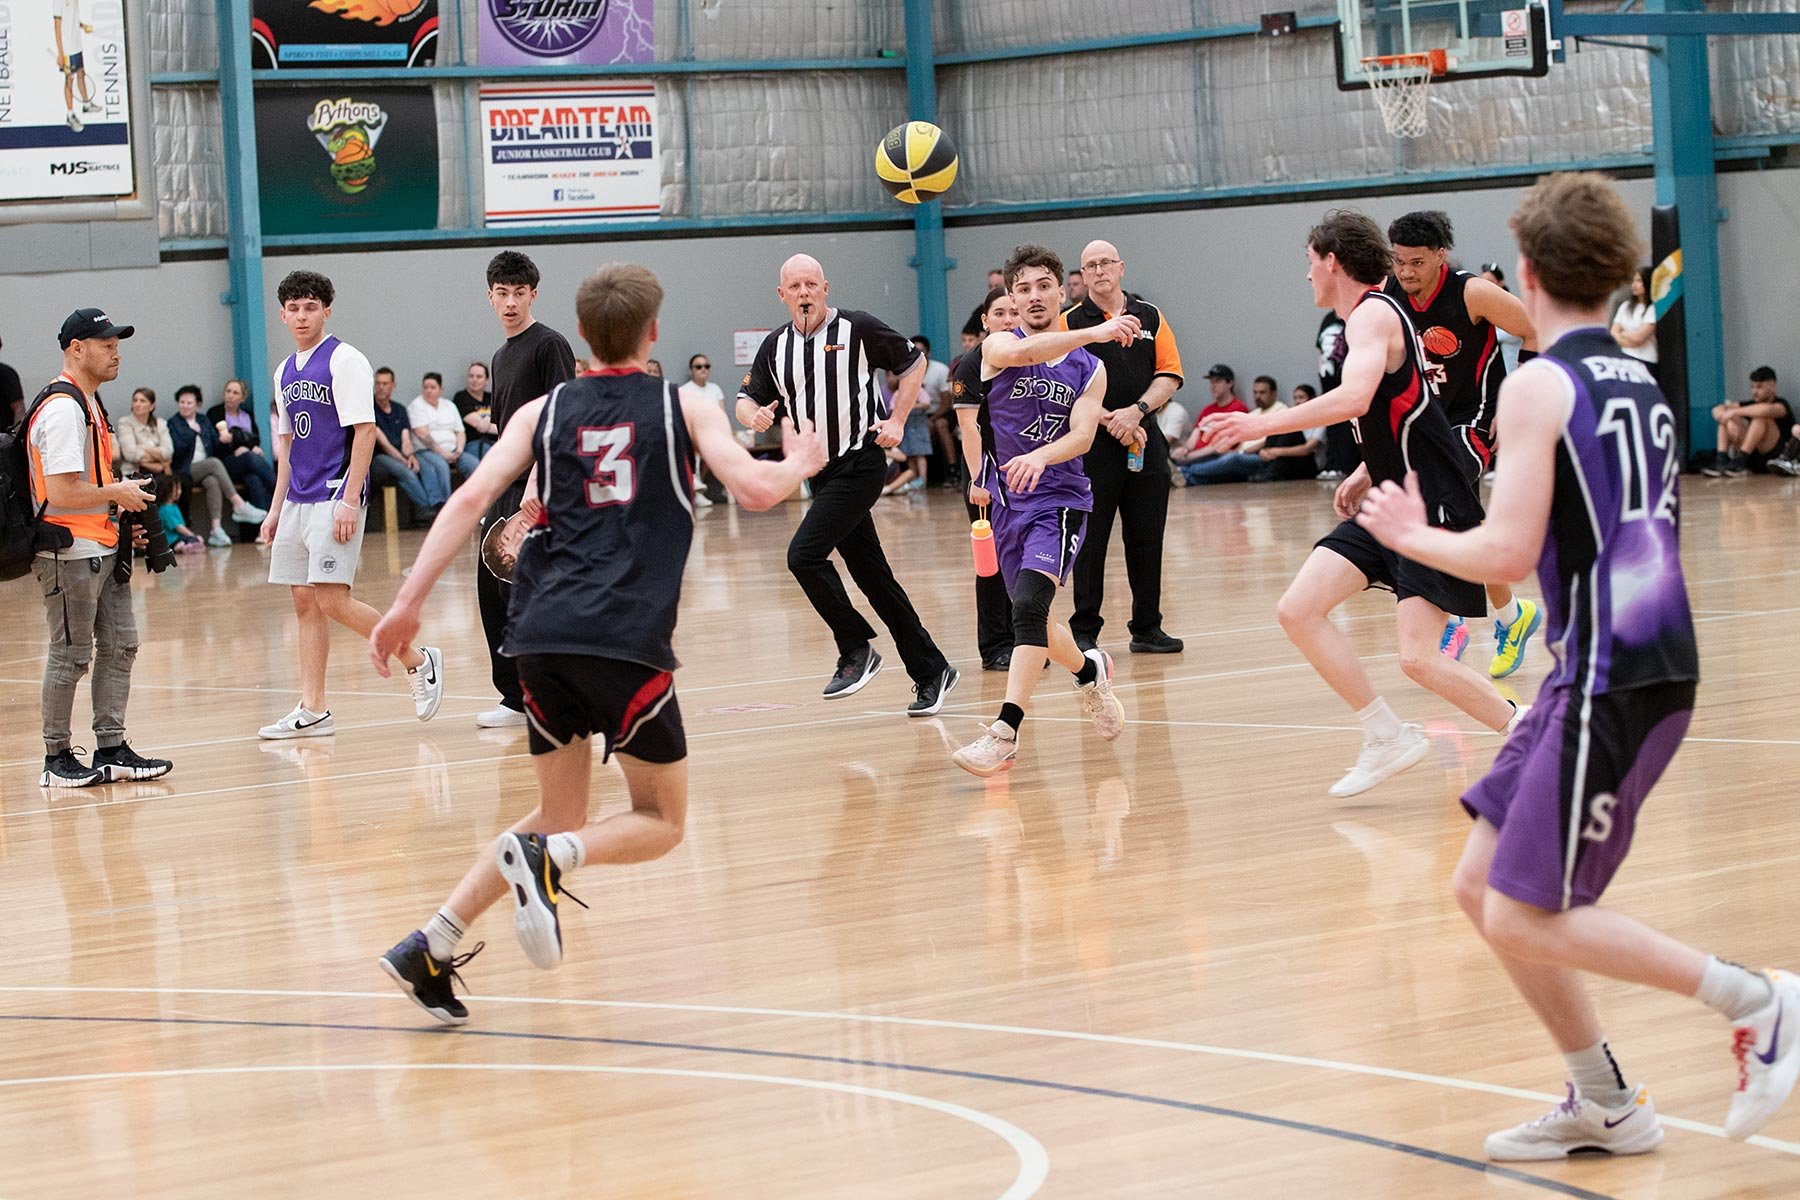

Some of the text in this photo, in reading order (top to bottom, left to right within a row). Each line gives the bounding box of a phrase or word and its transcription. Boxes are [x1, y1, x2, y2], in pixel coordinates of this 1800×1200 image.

[102, 43, 120, 119] TENNIS
[318, 103, 378, 126] Pythons
[489, 106, 652, 141] DREAMTEAM
[50, 161, 87, 174] MJS
[496, 147, 612, 159] JUNIOR BASKETBALL CLUB
[1019, 413, 1068, 443] 47
[577, 422, 636, 508] 3
[1595, 397, 1679, 526] 12
[1068, 534, 1079, 555] S
[1583, 792, 1617, 842] S
